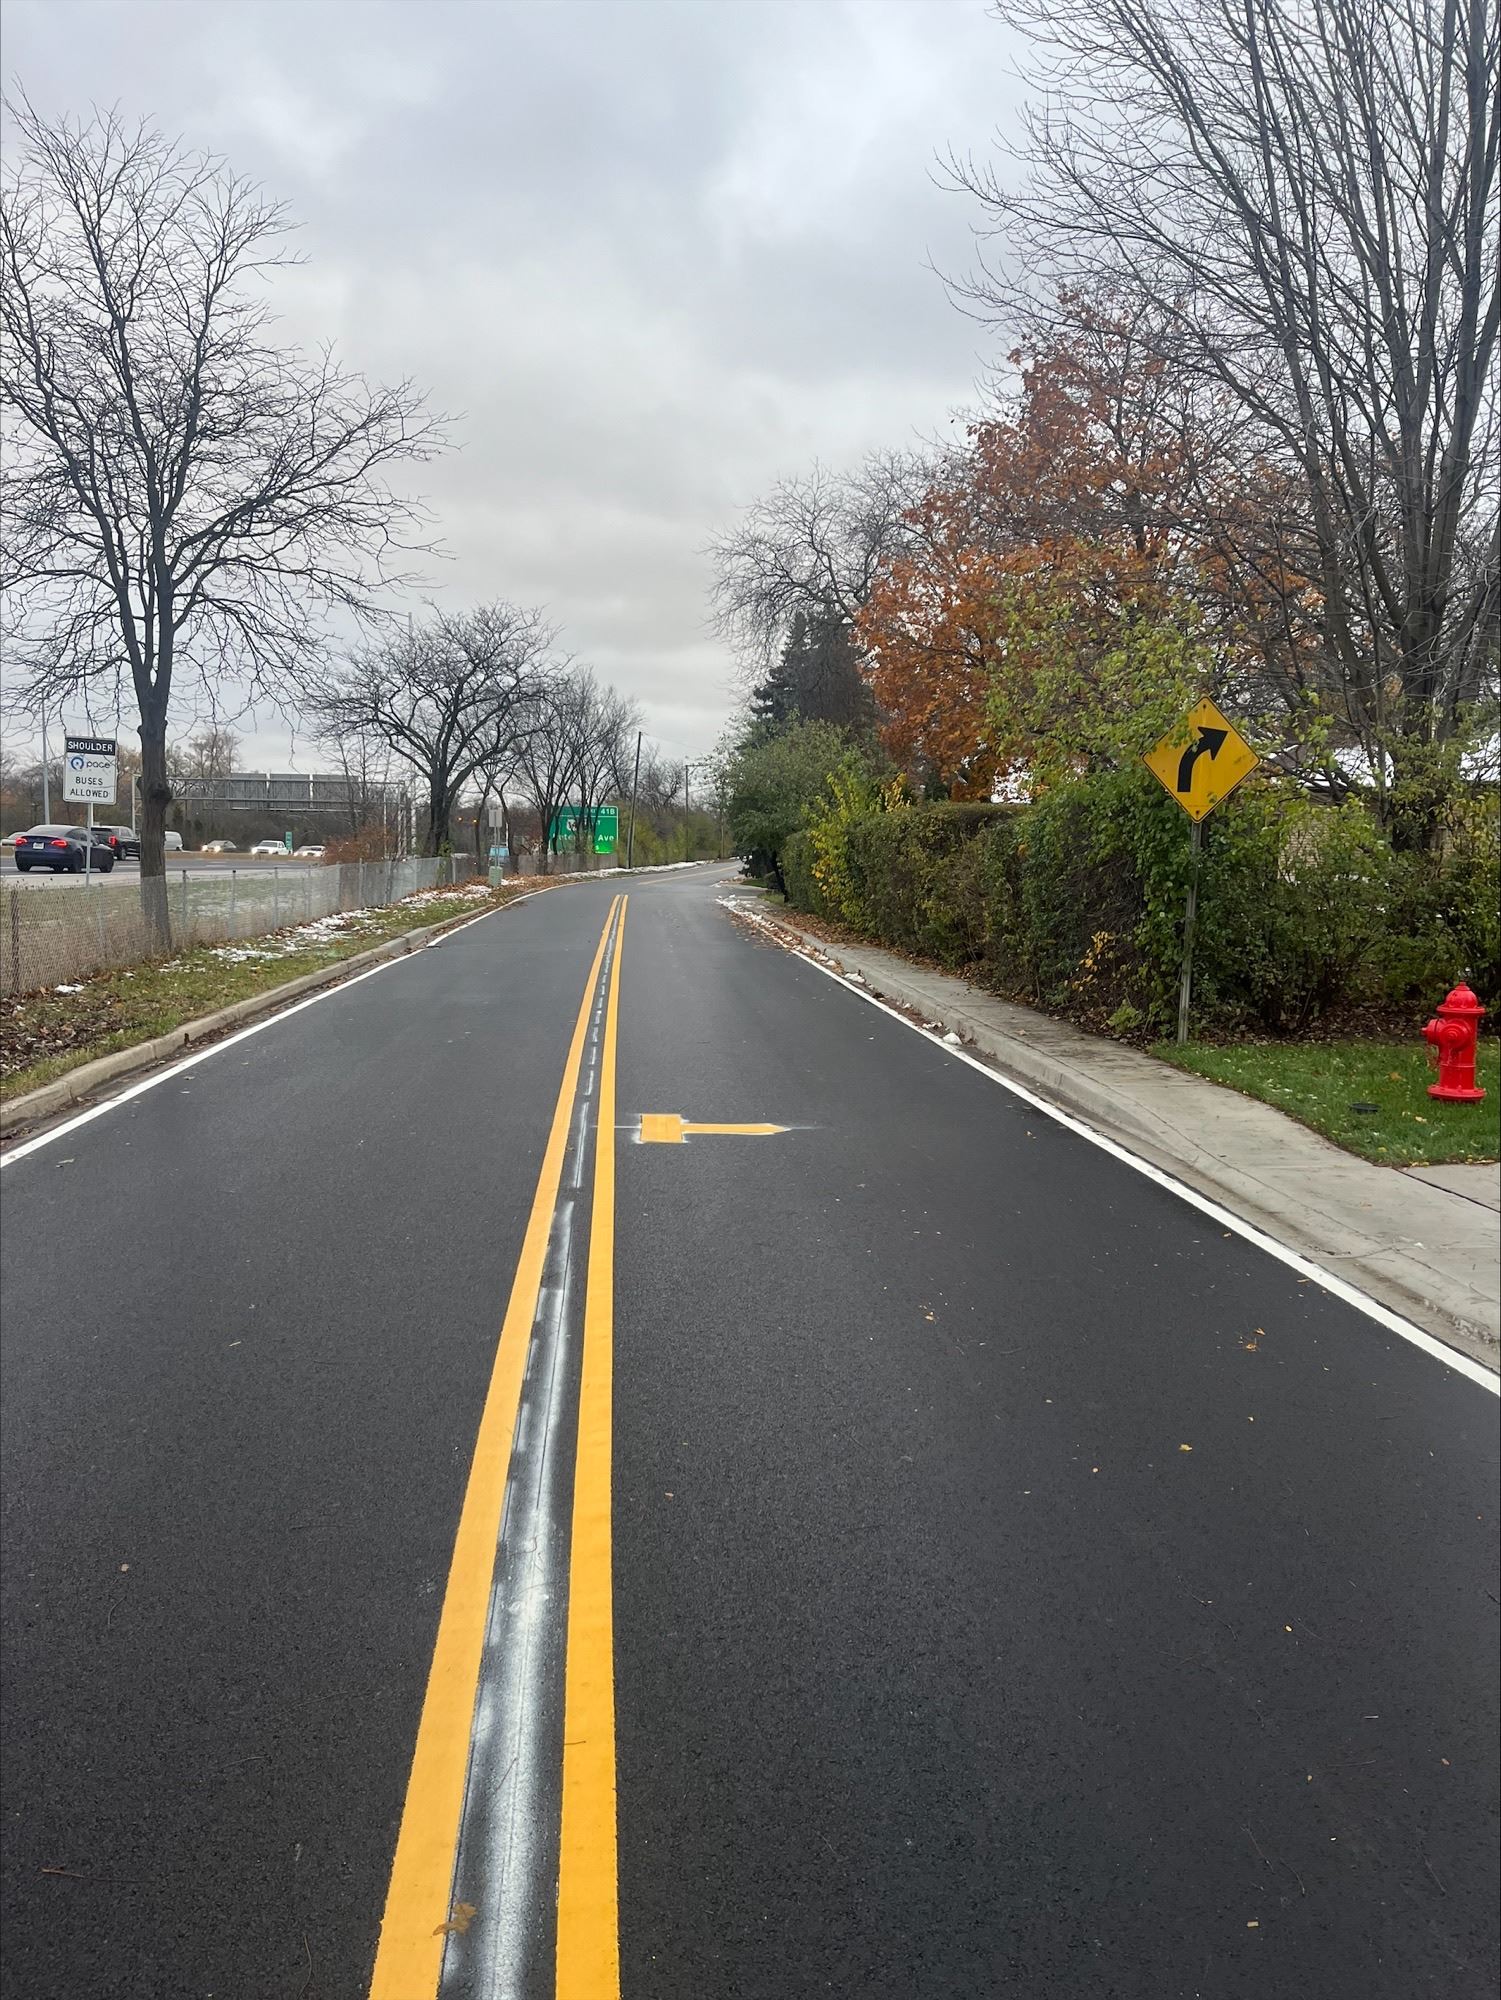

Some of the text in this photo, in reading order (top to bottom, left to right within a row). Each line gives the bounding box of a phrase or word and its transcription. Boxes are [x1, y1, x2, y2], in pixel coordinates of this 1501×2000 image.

[68, 741, 113, 752] SHOULDER
[86, 761, 111, 769] pace
[75, 776, 104, 785] BUSES
[70, 788, 109, 798] ALLOWED
